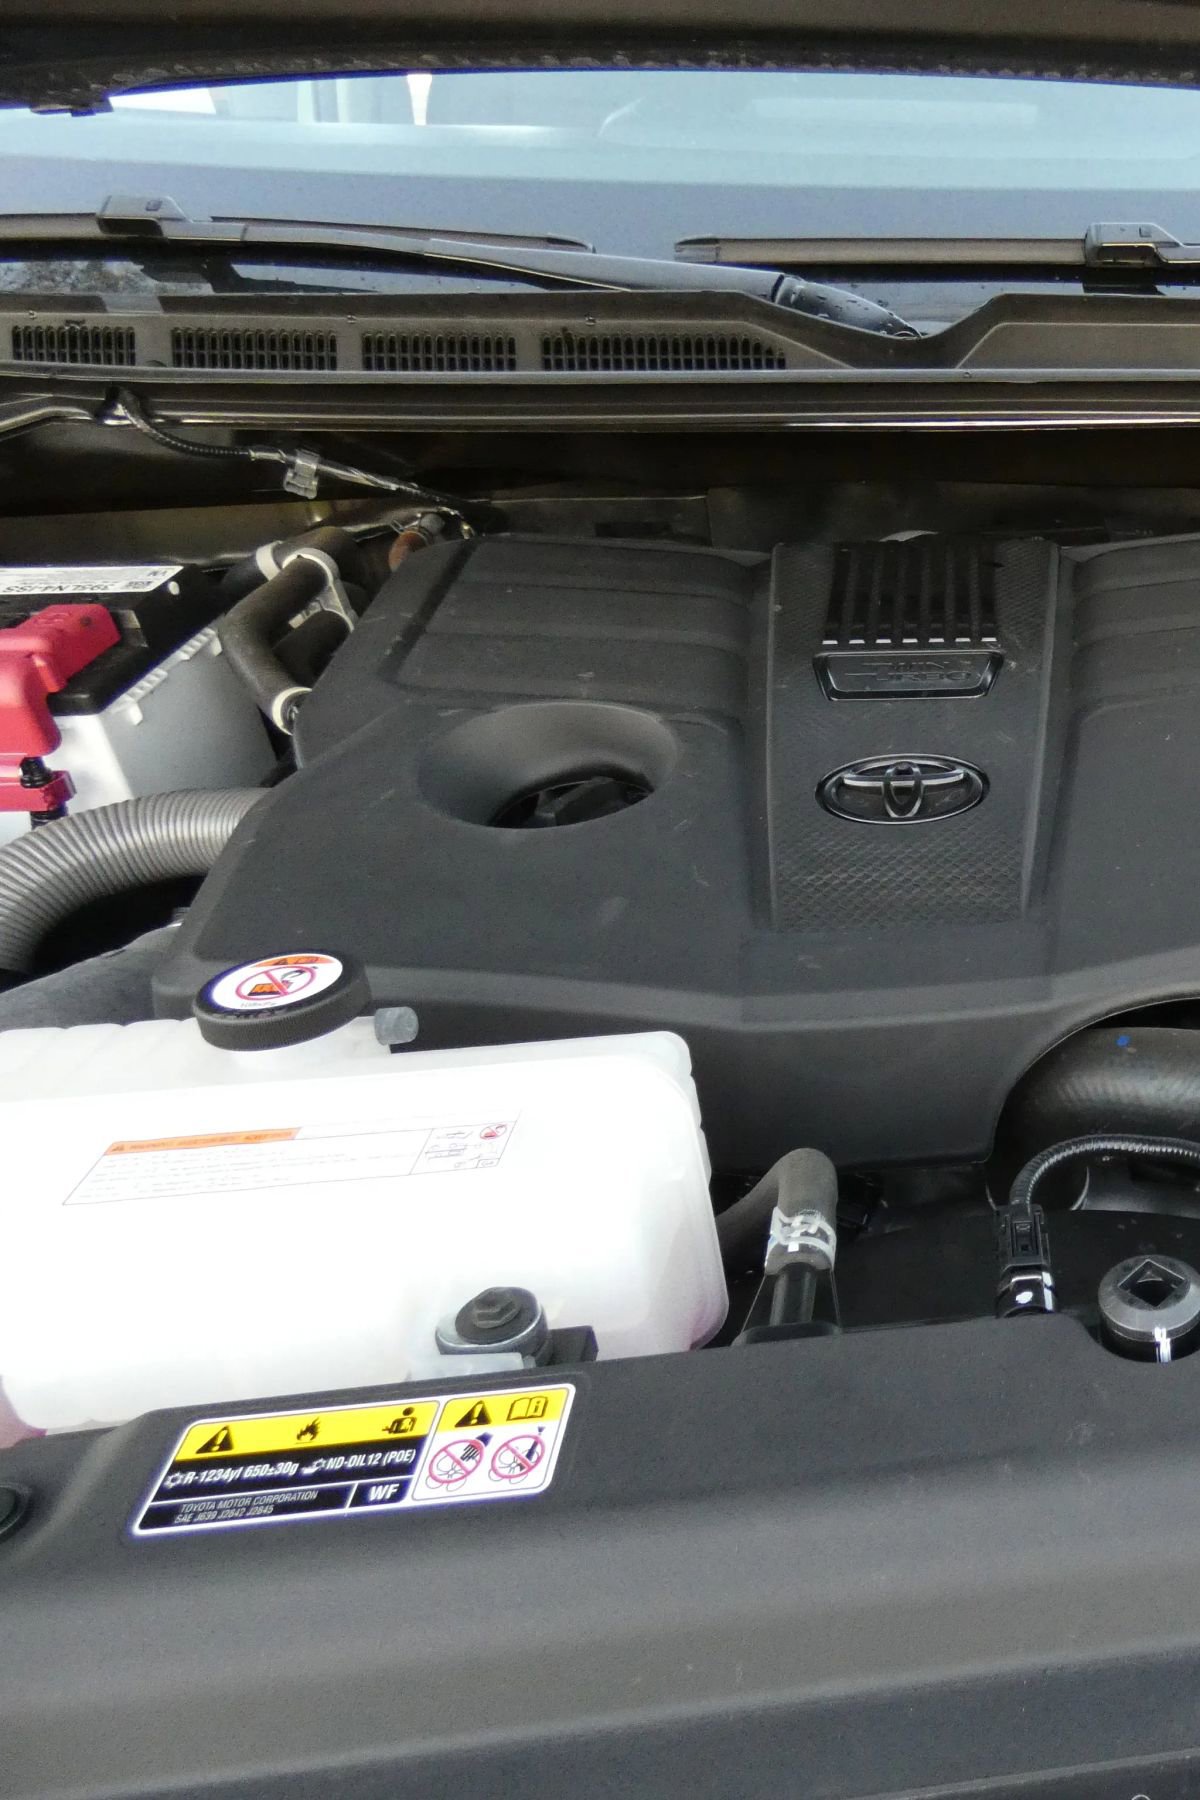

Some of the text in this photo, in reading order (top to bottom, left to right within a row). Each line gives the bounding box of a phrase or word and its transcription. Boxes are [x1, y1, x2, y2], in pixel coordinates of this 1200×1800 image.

[383, 1448, 417, 1466] (POE)
[183, 1462, 300, 1484] R-1234yf 650±30g
[369, 1483, 400, 1501] WF
[181, 1490, 319, 1513] TOYOTA MOTOR CORPORATION
[174, 1513, 194, 1524] SAE
